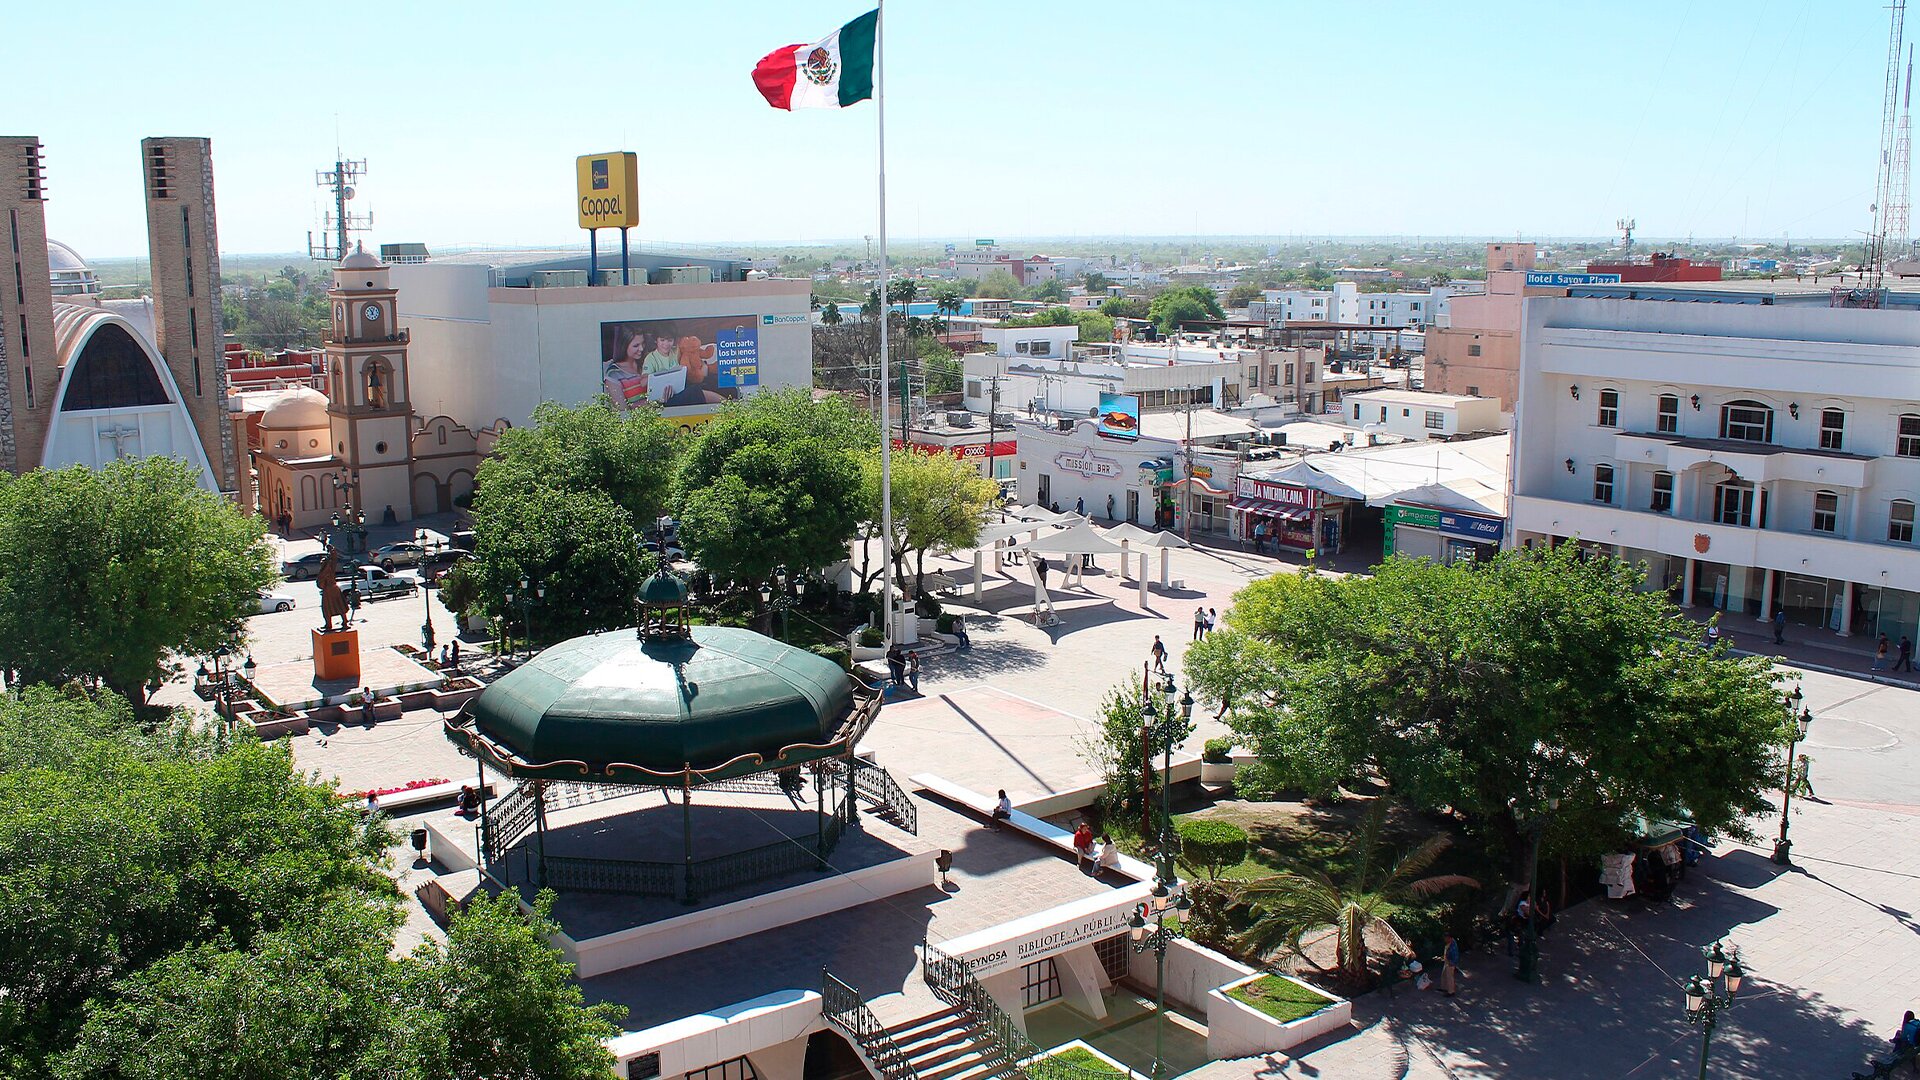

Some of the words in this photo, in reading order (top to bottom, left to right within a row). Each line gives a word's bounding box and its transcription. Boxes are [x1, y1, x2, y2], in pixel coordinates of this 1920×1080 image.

[581, 194, 623, 221] Coppel
[1528, 274, 1552, 283] Hotel
[1557, 275, 1584, 284] Savoy
[1589, 276, 1615, 284] Plaza
[774, 315, 807, 324] BanCoppel
[718, 349, 730, 357] los
[964, 446, 985, 456] OXXO
[1097, 463, 1111, 474] BAR
[1254, 483, 1263, 498] LA
[1262, 485, 1304, 505] MICHOACANA
[1476, 523, 1499, 533] telcel
[1018, 927, 1080, 954] BIBLIOTEA
[965, 949, 1008, 970] REYNOSA
